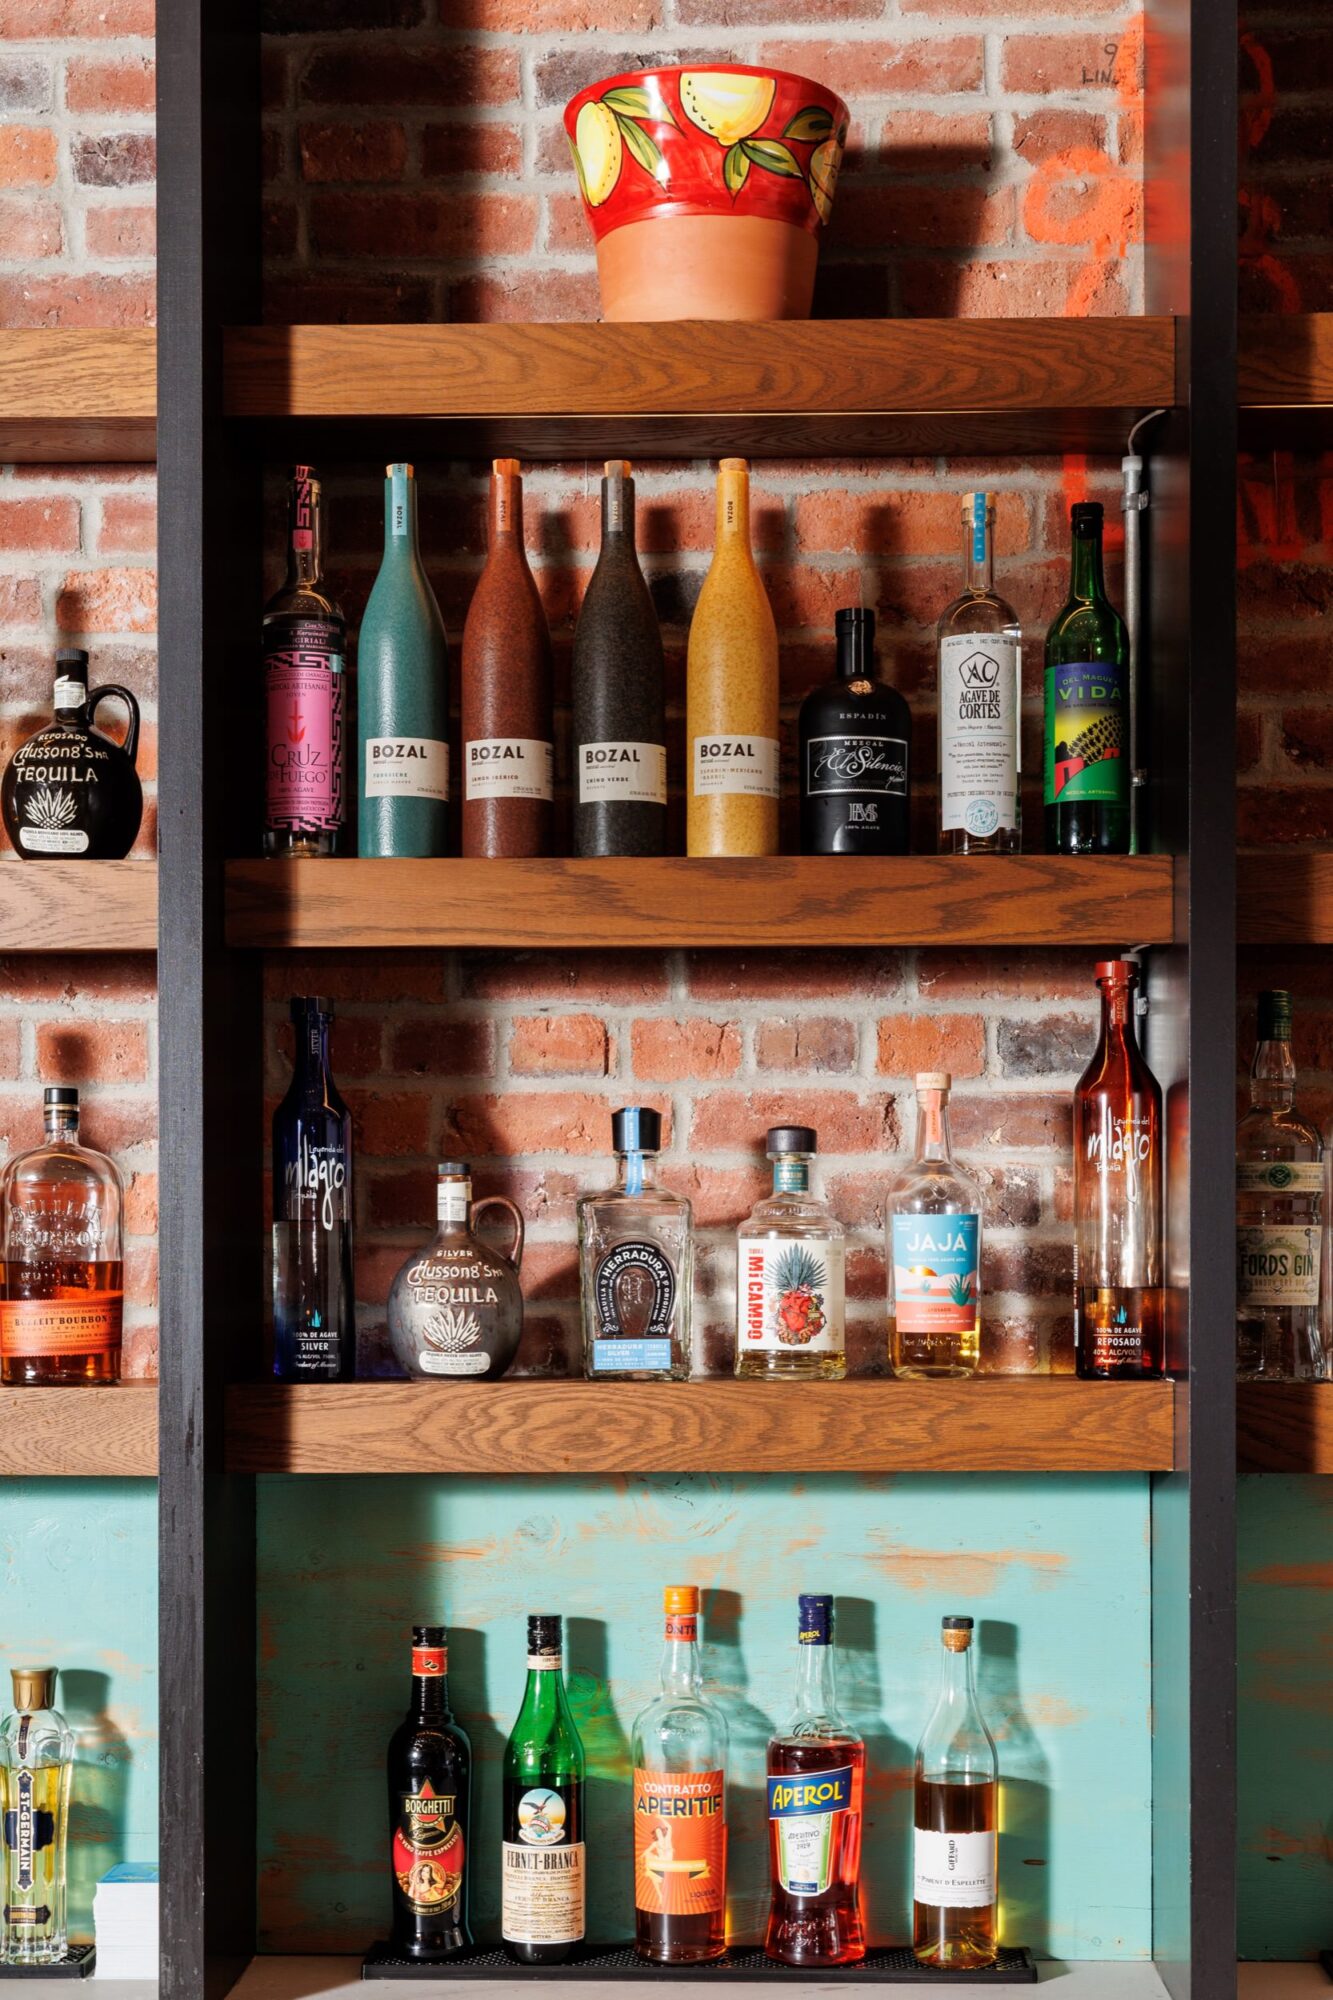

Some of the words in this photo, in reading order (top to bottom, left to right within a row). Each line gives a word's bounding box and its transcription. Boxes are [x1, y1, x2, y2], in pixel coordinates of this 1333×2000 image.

[1104, 43, 1119, 67] 9
[960, 690, 987, 704] AGAVE
[989, 690, 1001, 703] DE
[1059, 686, 1121, 700] VIDA
[38, 732, 88, 742] REPOSADO
[373, 744, 428, 759] BOZAL
[472, 745, 525, 761] BOZAL
[586, 749, 640, 764] BOZAL
[700, 743, 755, 758] BOZAL
[16, 766, 98, 782] TEQUILA
[906, 1232, 967, 1252] JAJA
[436, 1250, 473, 1258] SILVER
[602, 1250, 667, 1280] HERRADURA
[1240, 1254, 1289, 1277] FORDS
[1294, 1254, 1314, 1277] GIN
[413, 1286, 499, 1304] TEQUILA
[601, 1287, 611, 1321] TEQUILA
[659, 1287, 670, 1321] ORIGINAL
[59, 1315, 108, 1325] BOURBON
[301, 1342, 329, 1351] SILVER
[1097, 1337, 1141, 1346] REPOSADO
[643, 1782, 711, 1795] CONTRATTO
[772, 1781, 843, 1811] APEROL
[405, 1799, 451, 1814] BORGHETTI
[20, 1791, 32, 1871] ST-GERMAIN
[507, 1850, 579, 1870] FERNET-BRANCA
